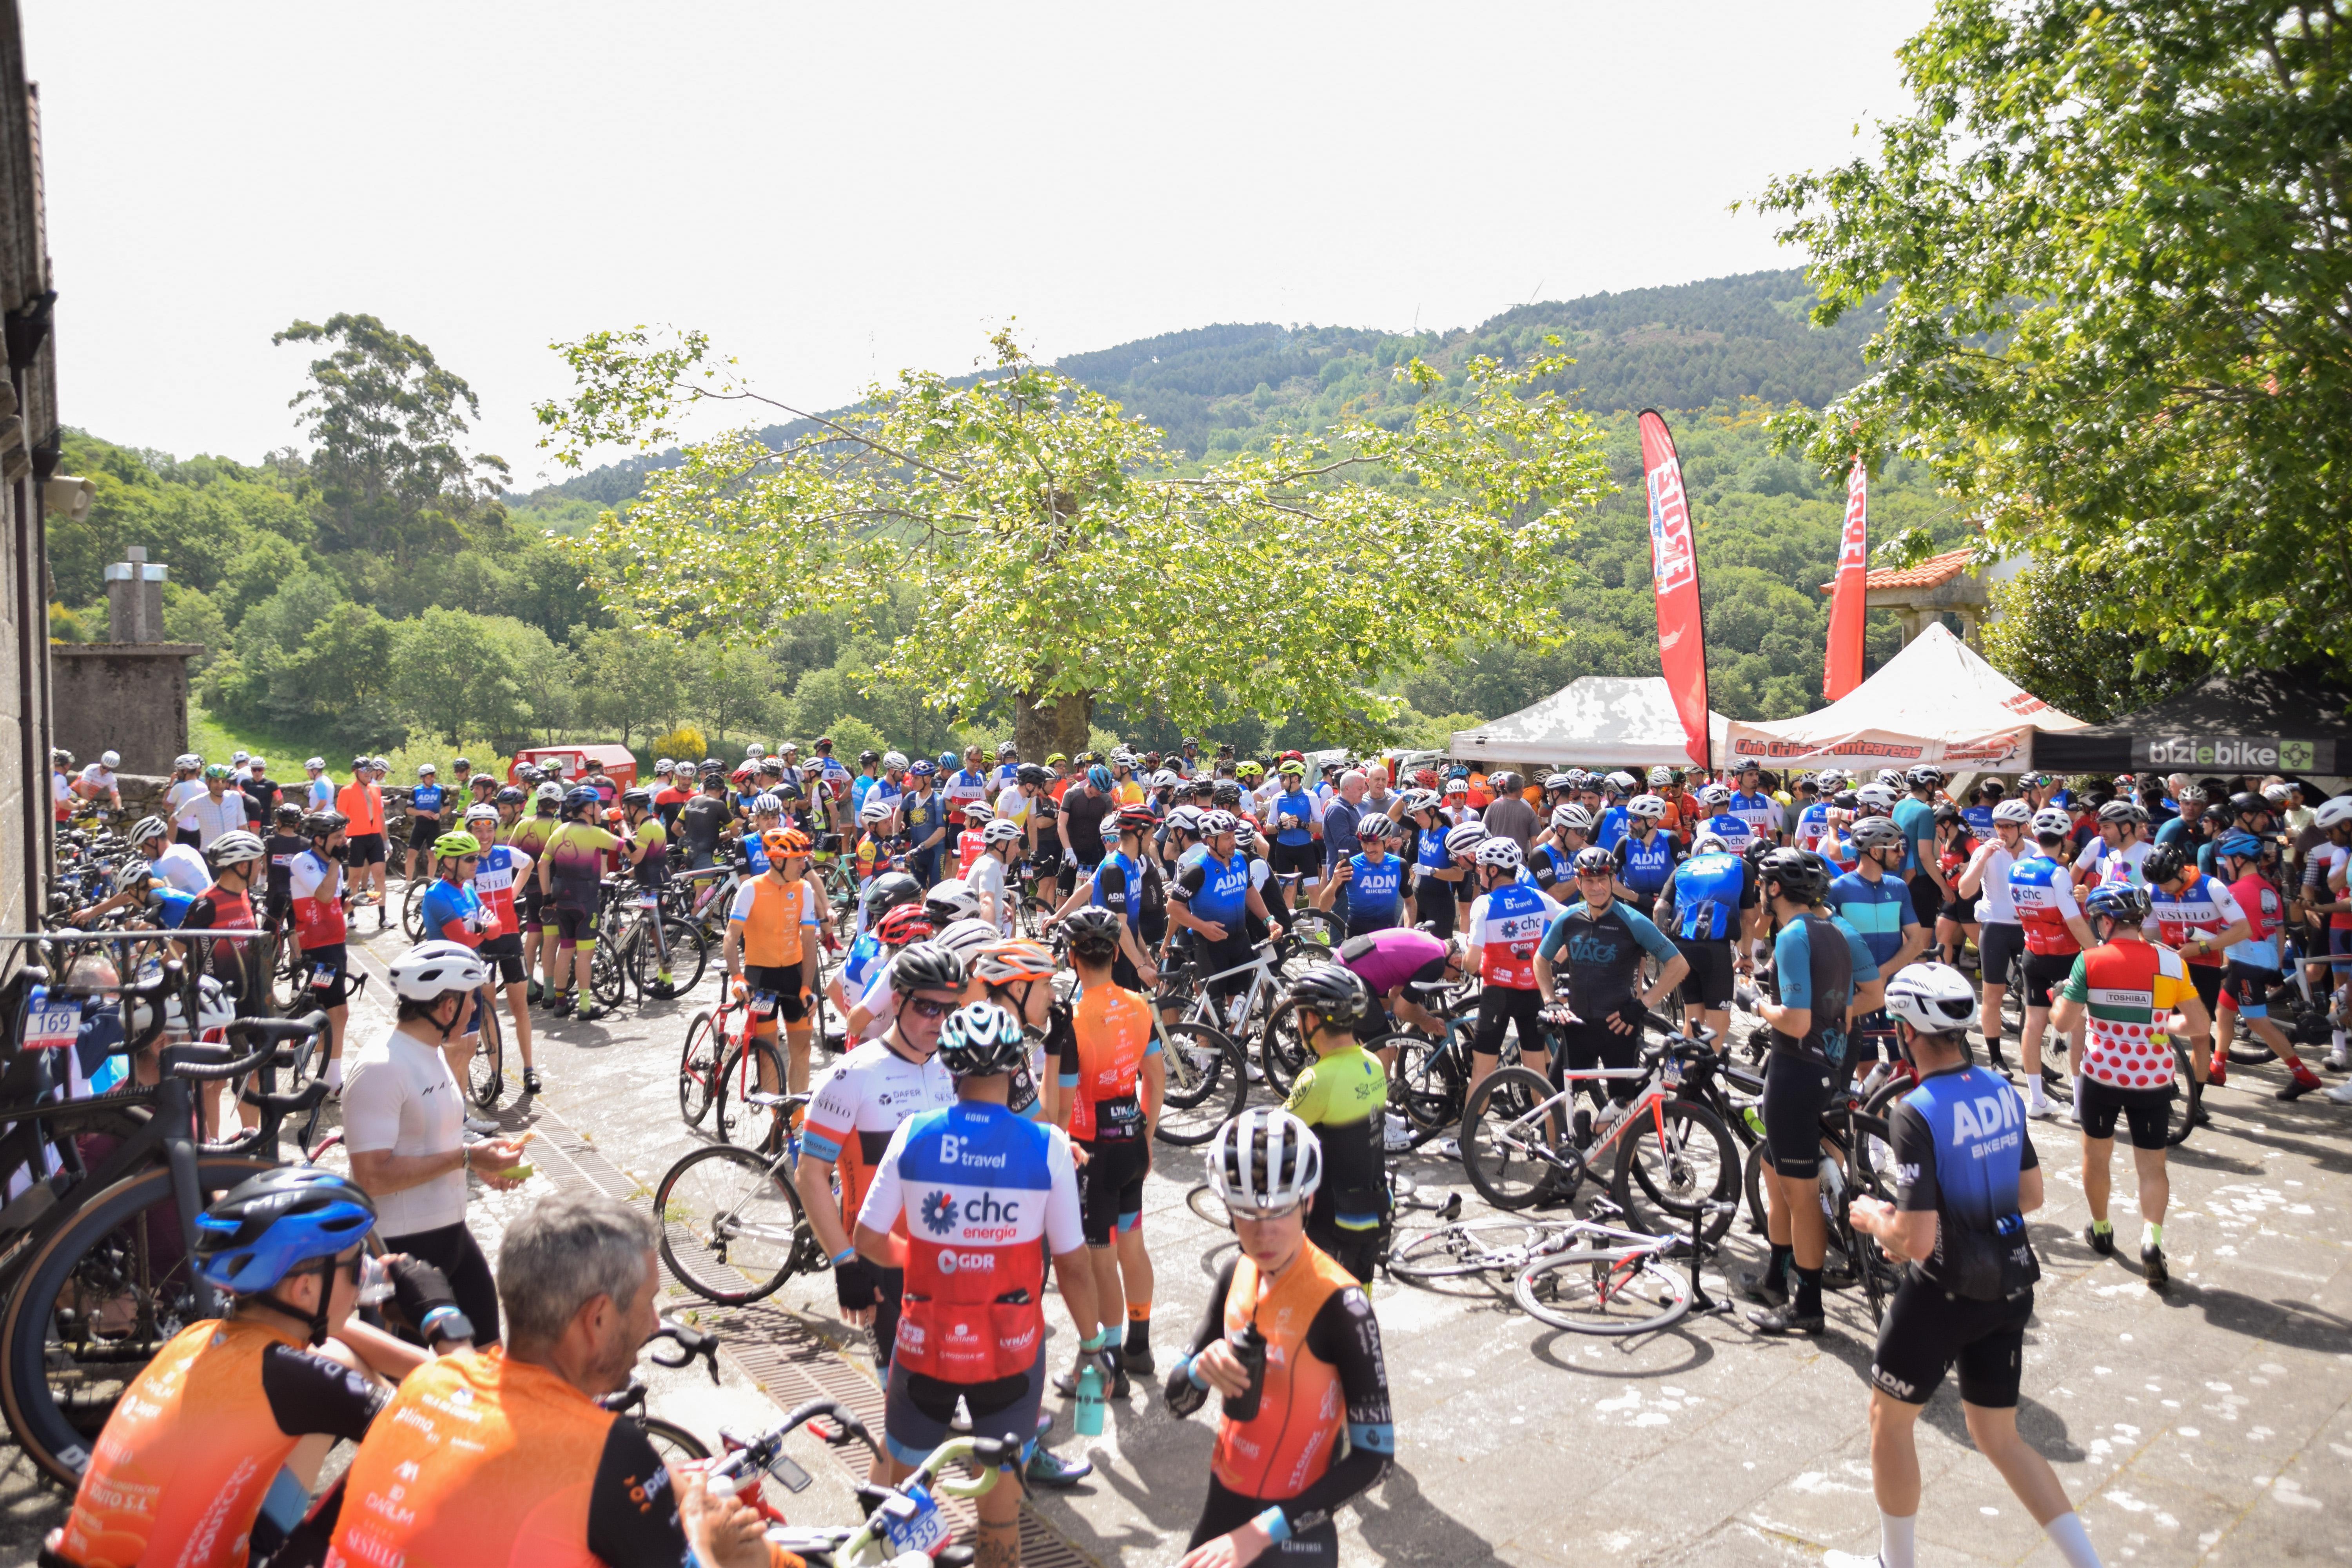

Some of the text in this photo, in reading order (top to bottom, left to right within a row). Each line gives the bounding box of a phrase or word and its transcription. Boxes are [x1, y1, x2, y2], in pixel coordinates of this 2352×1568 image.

[1735, 739, 1766, 756] Club
[1731, 836, 1745, 845] chc
[1976, 828, 1991, 838] chc
[1630, 850, 1665, 865] ADN
[1537, 867, 1553, 878] ADN
[1213, 870, 1247, 893] ADN
[1359, 874, 1396, 888] ADN
[1108, 892, 1125, 901] ADN
[1173, 883, 1193, 897] ADN
[1221, 886, 1245, 897] BIKERS
[2023, 887, 2042, 900] chc
[706, 888, 725, 910] BMC
[1514, 898, 1533, 909] travel
[1521, 915, 1540, 930] chc
[2157, 910, 2210, 922] SESTELO
[2108, 993, 2147, 1003] TOSHIBA
[38, 1013, 71, 1033] 169
[892, 1089, 921, 1098] DAFER
[1953, 1085, 2020, 1146] ADN
[1591, 1098, 1639, 1151] SPECIALIZED
[962, 1152, 1006, 1169] travel
[1896, 1163, 1920, 1178] DN
[964, 1191, 1019, 1223] chc
[963, 1224, 1017, 1243] energía
[958, 1253, 995, 1268] GDR
[1366, 1318, 1387, 1387] DAFER
[906, 1519, 938, 1550] 239
